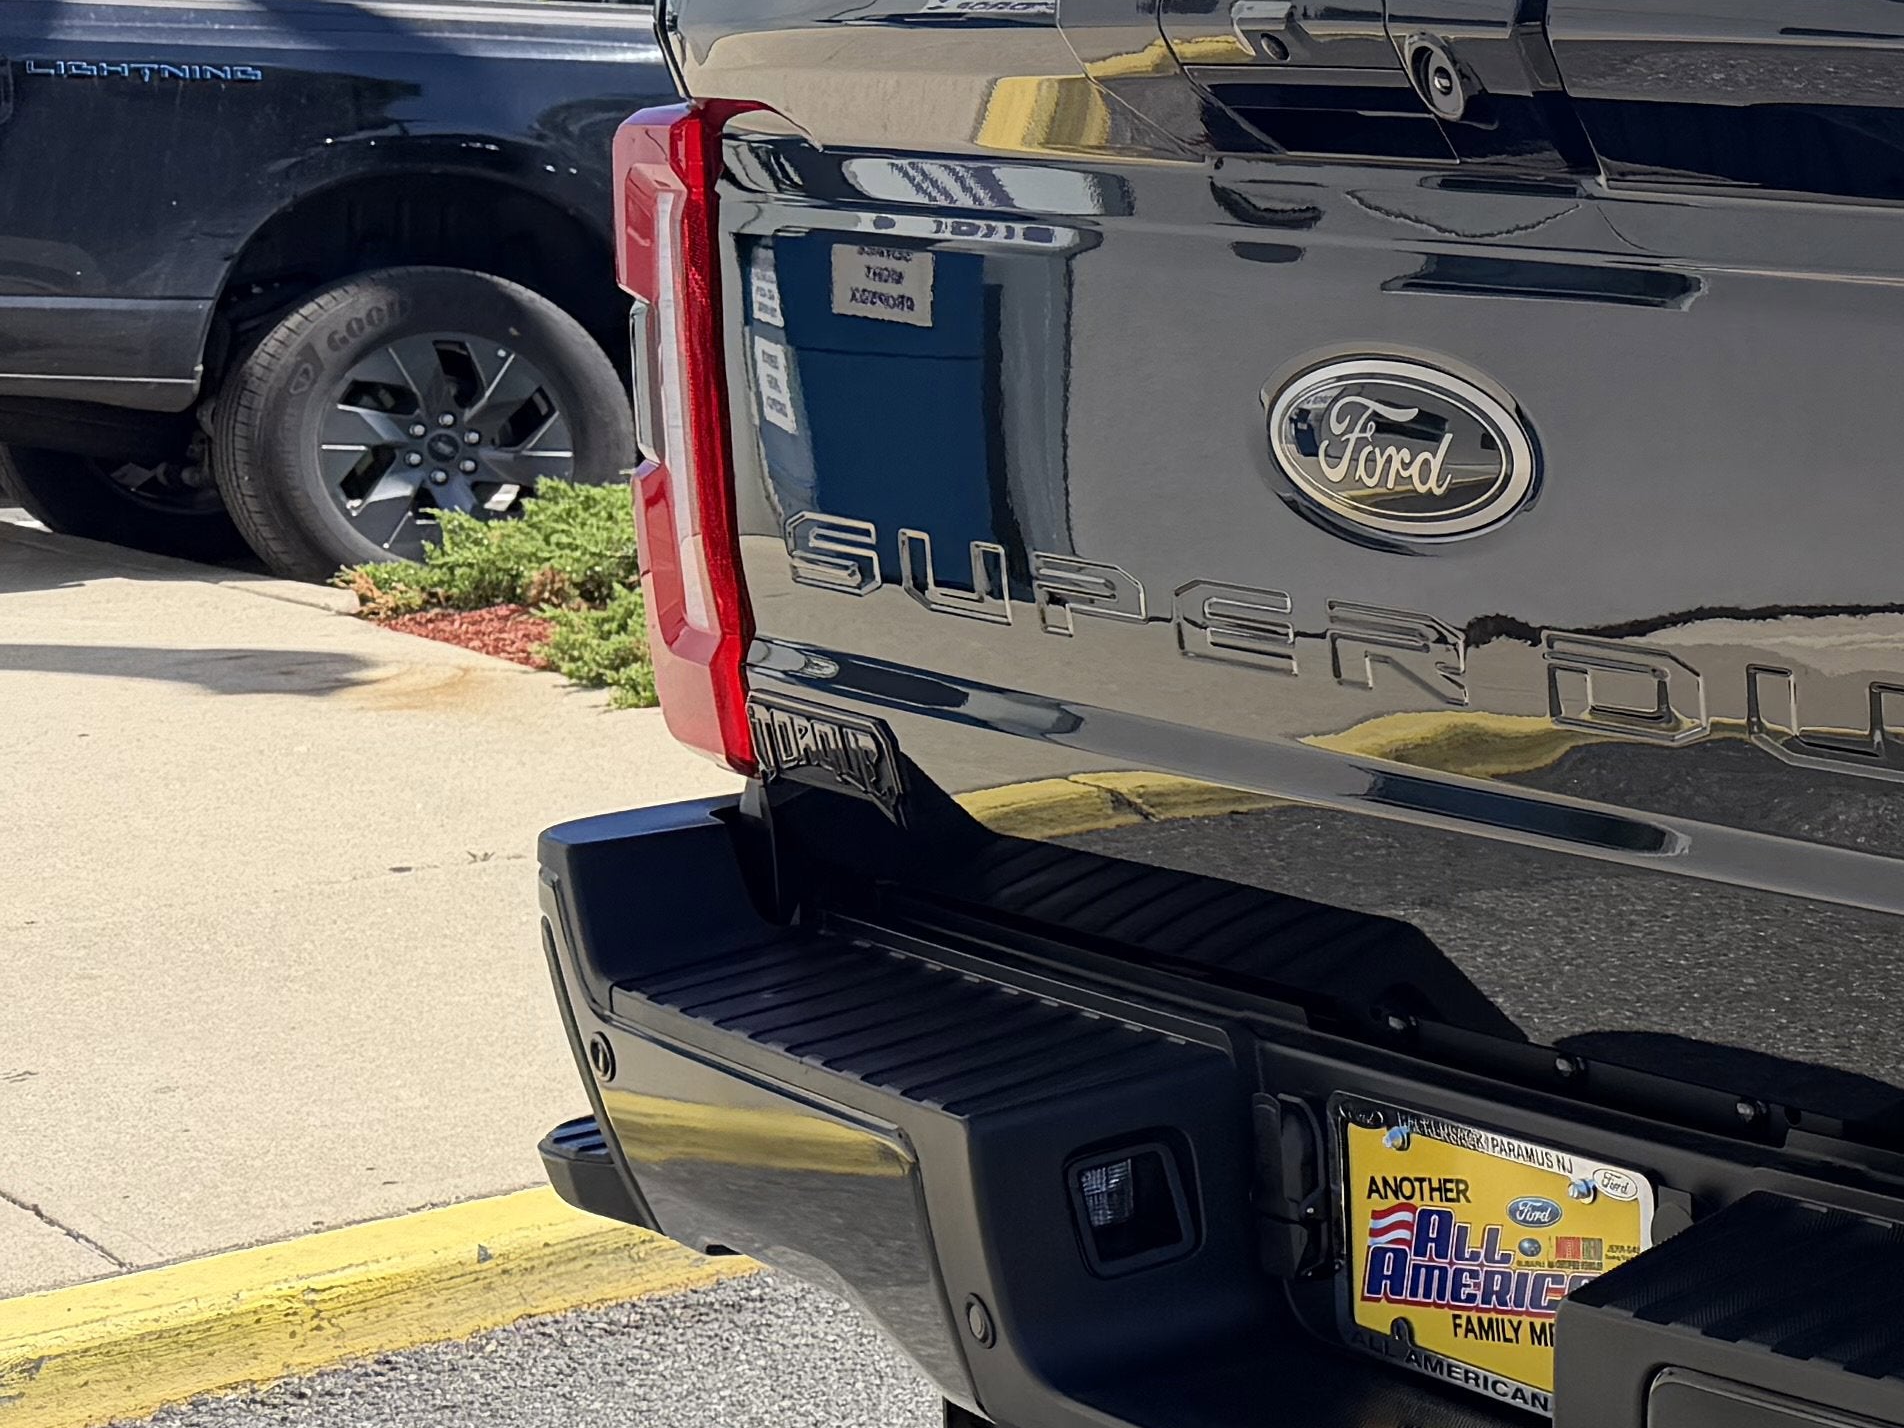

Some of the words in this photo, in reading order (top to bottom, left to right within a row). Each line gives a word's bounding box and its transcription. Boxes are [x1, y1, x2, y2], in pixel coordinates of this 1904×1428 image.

[26, 60, 262, 83] LIGHTNING
[1318, 395, 1454, 497] Ford
[783, 509, 1470, 706] SUPER
[1490, 1136, 1554, 1169] PARAMUS
[1556, 1154, 1574, 1174] NJ
[1366, 1175, 1472, 1203] ANOTHER
[1515, 1200, 1552, 1223] Ford
[1412, 1206, 1516, 1266] ALL
[1451, 1313, 1523, 1345] FAMILY
[1404, 1348, 1549, 1412] AMERICAN
